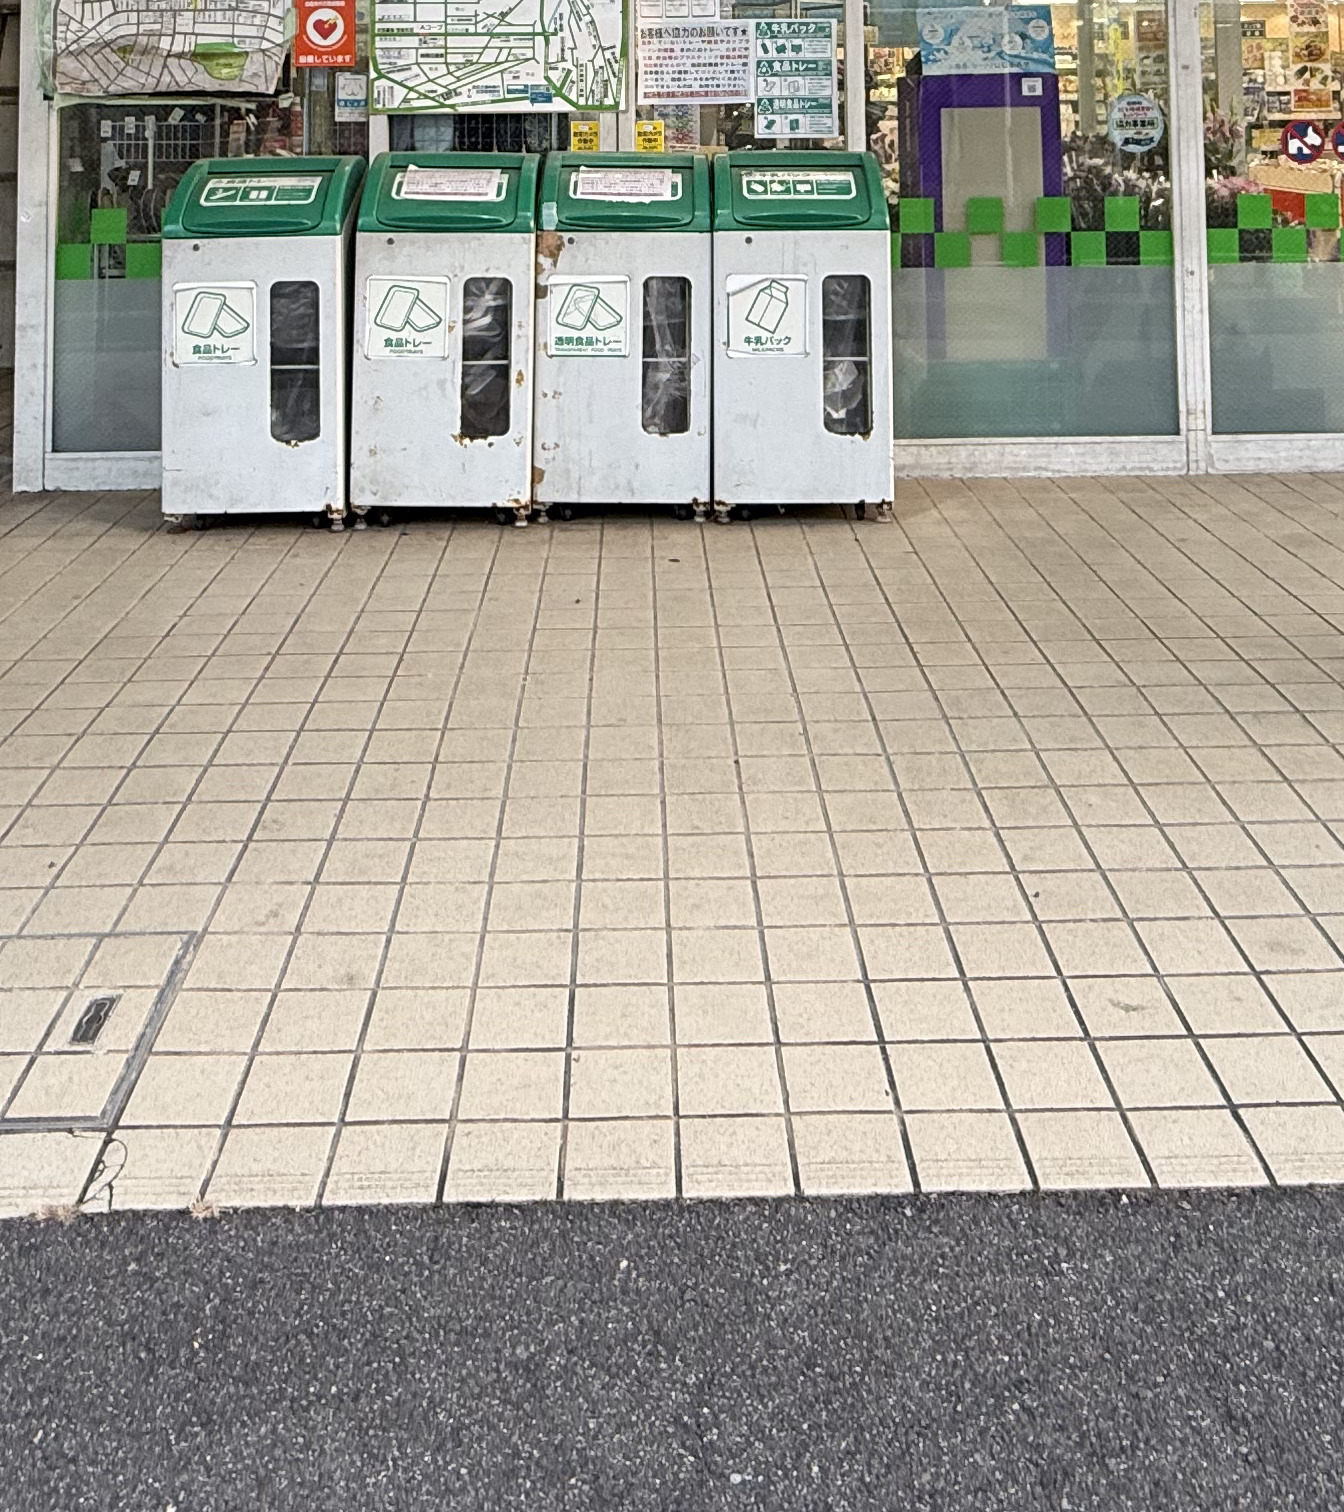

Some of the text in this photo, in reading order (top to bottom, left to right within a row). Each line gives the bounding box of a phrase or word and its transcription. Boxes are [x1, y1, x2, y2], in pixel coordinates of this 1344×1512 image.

[771, 22, 816, 35] 牛乳パック
[772, 60, 817, 72] 食品トレー
[384, 338, 433, 348] 食品トレー
[554, 336, 623, 347] 透明食品トレー
[743, 335, 792, 347] 牛乳パック
[192, 343, 241, 355] 食品トレー
